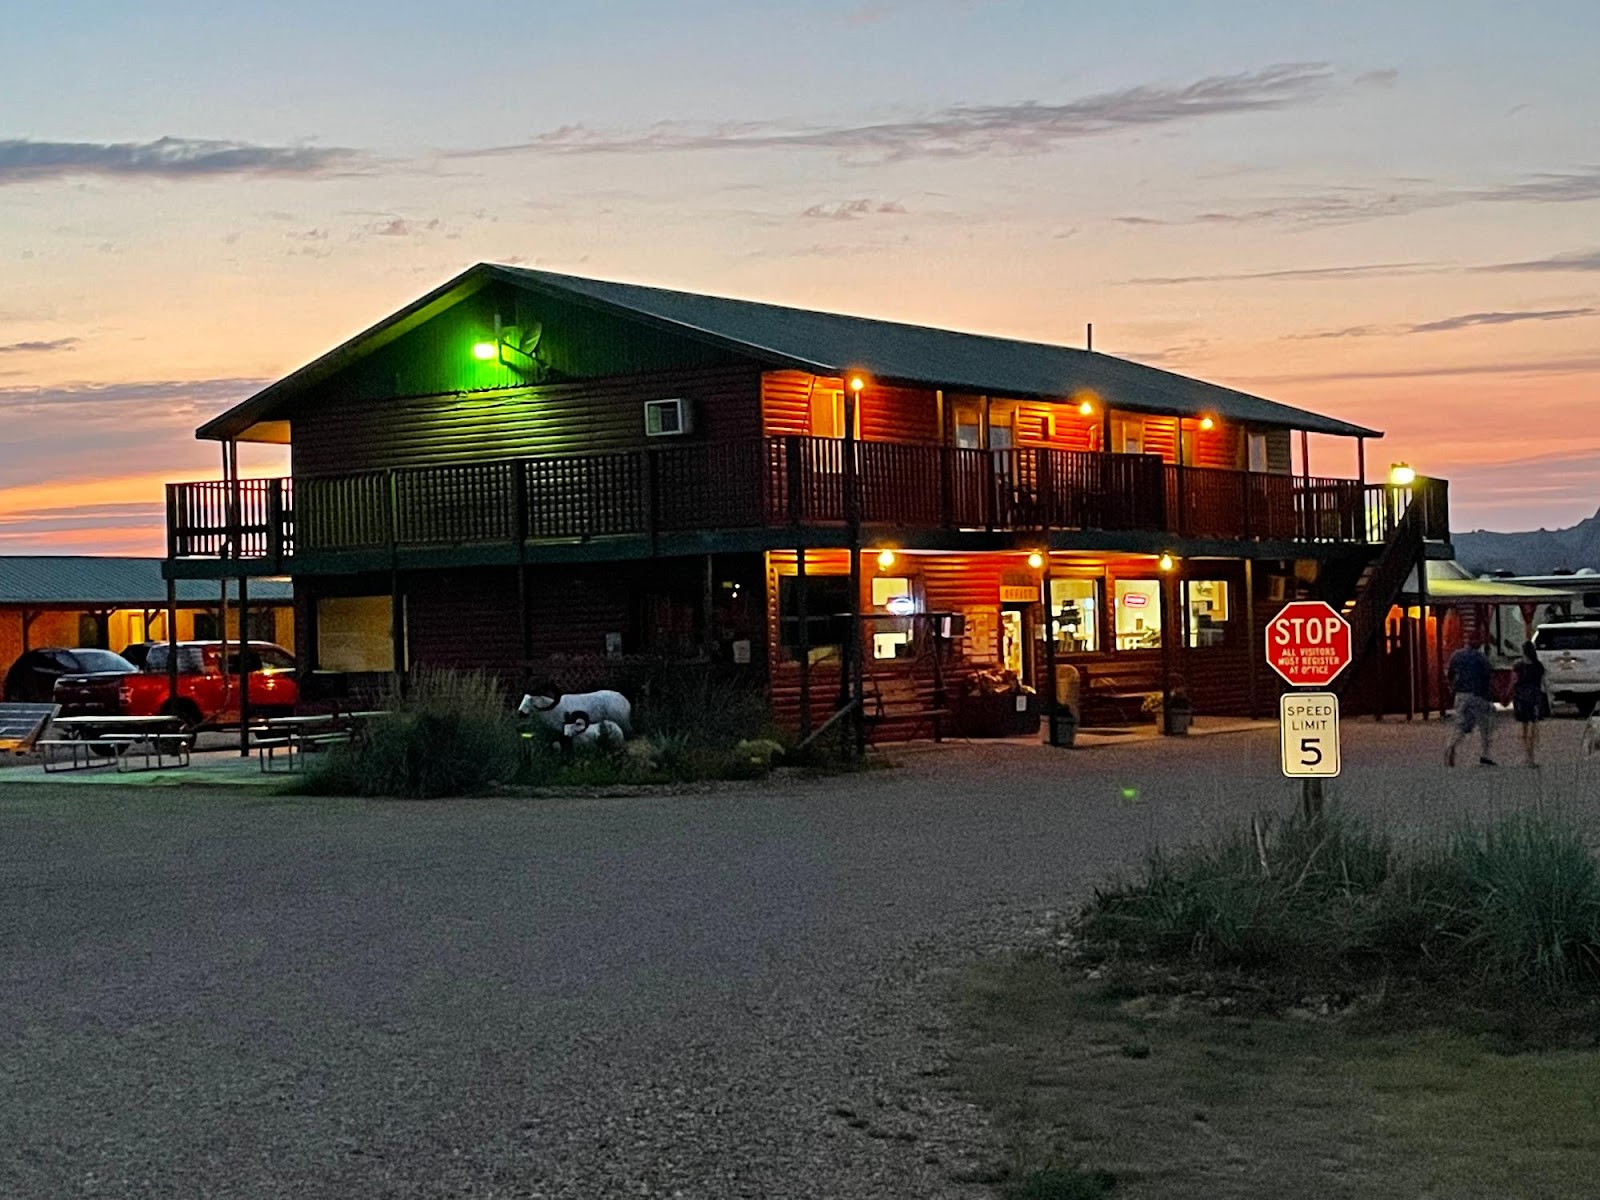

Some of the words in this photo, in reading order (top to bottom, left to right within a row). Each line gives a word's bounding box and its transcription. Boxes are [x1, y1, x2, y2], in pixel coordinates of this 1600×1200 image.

[1275, 617, 1341, 645] STOP
[1282, 648, 1296, 657] ALL
[1300, 647, 1336, 657] VISITORS
[1278, 656, 1299, 666] MUST
[1302, 656, 1340, 665] REGISTER
[1289, 666, 1299, 675] AT
[1287, 706, 1332, 716] SPEED
[1292, 720, 1327, 731] LIMIT
[1301, 738, 1322, 766] 5
